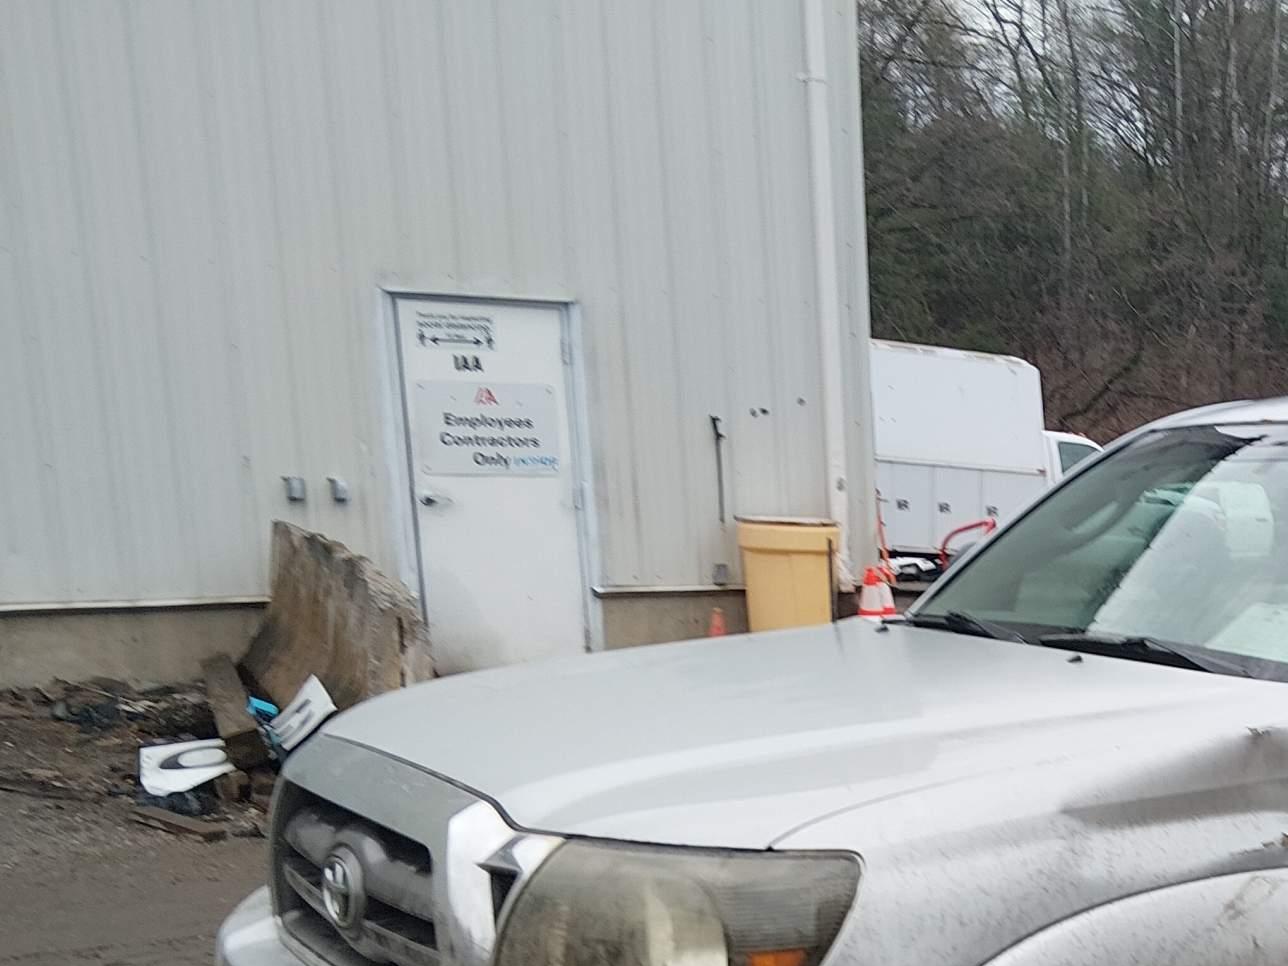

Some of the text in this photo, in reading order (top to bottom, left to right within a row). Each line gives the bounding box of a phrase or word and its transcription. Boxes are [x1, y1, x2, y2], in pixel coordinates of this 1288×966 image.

[452, 354, 485, 373] IAA
[443, 411, 536, 430] Employees
[439, 431, 542, 449] Contractors
[472, 451, 512, 469] Only
